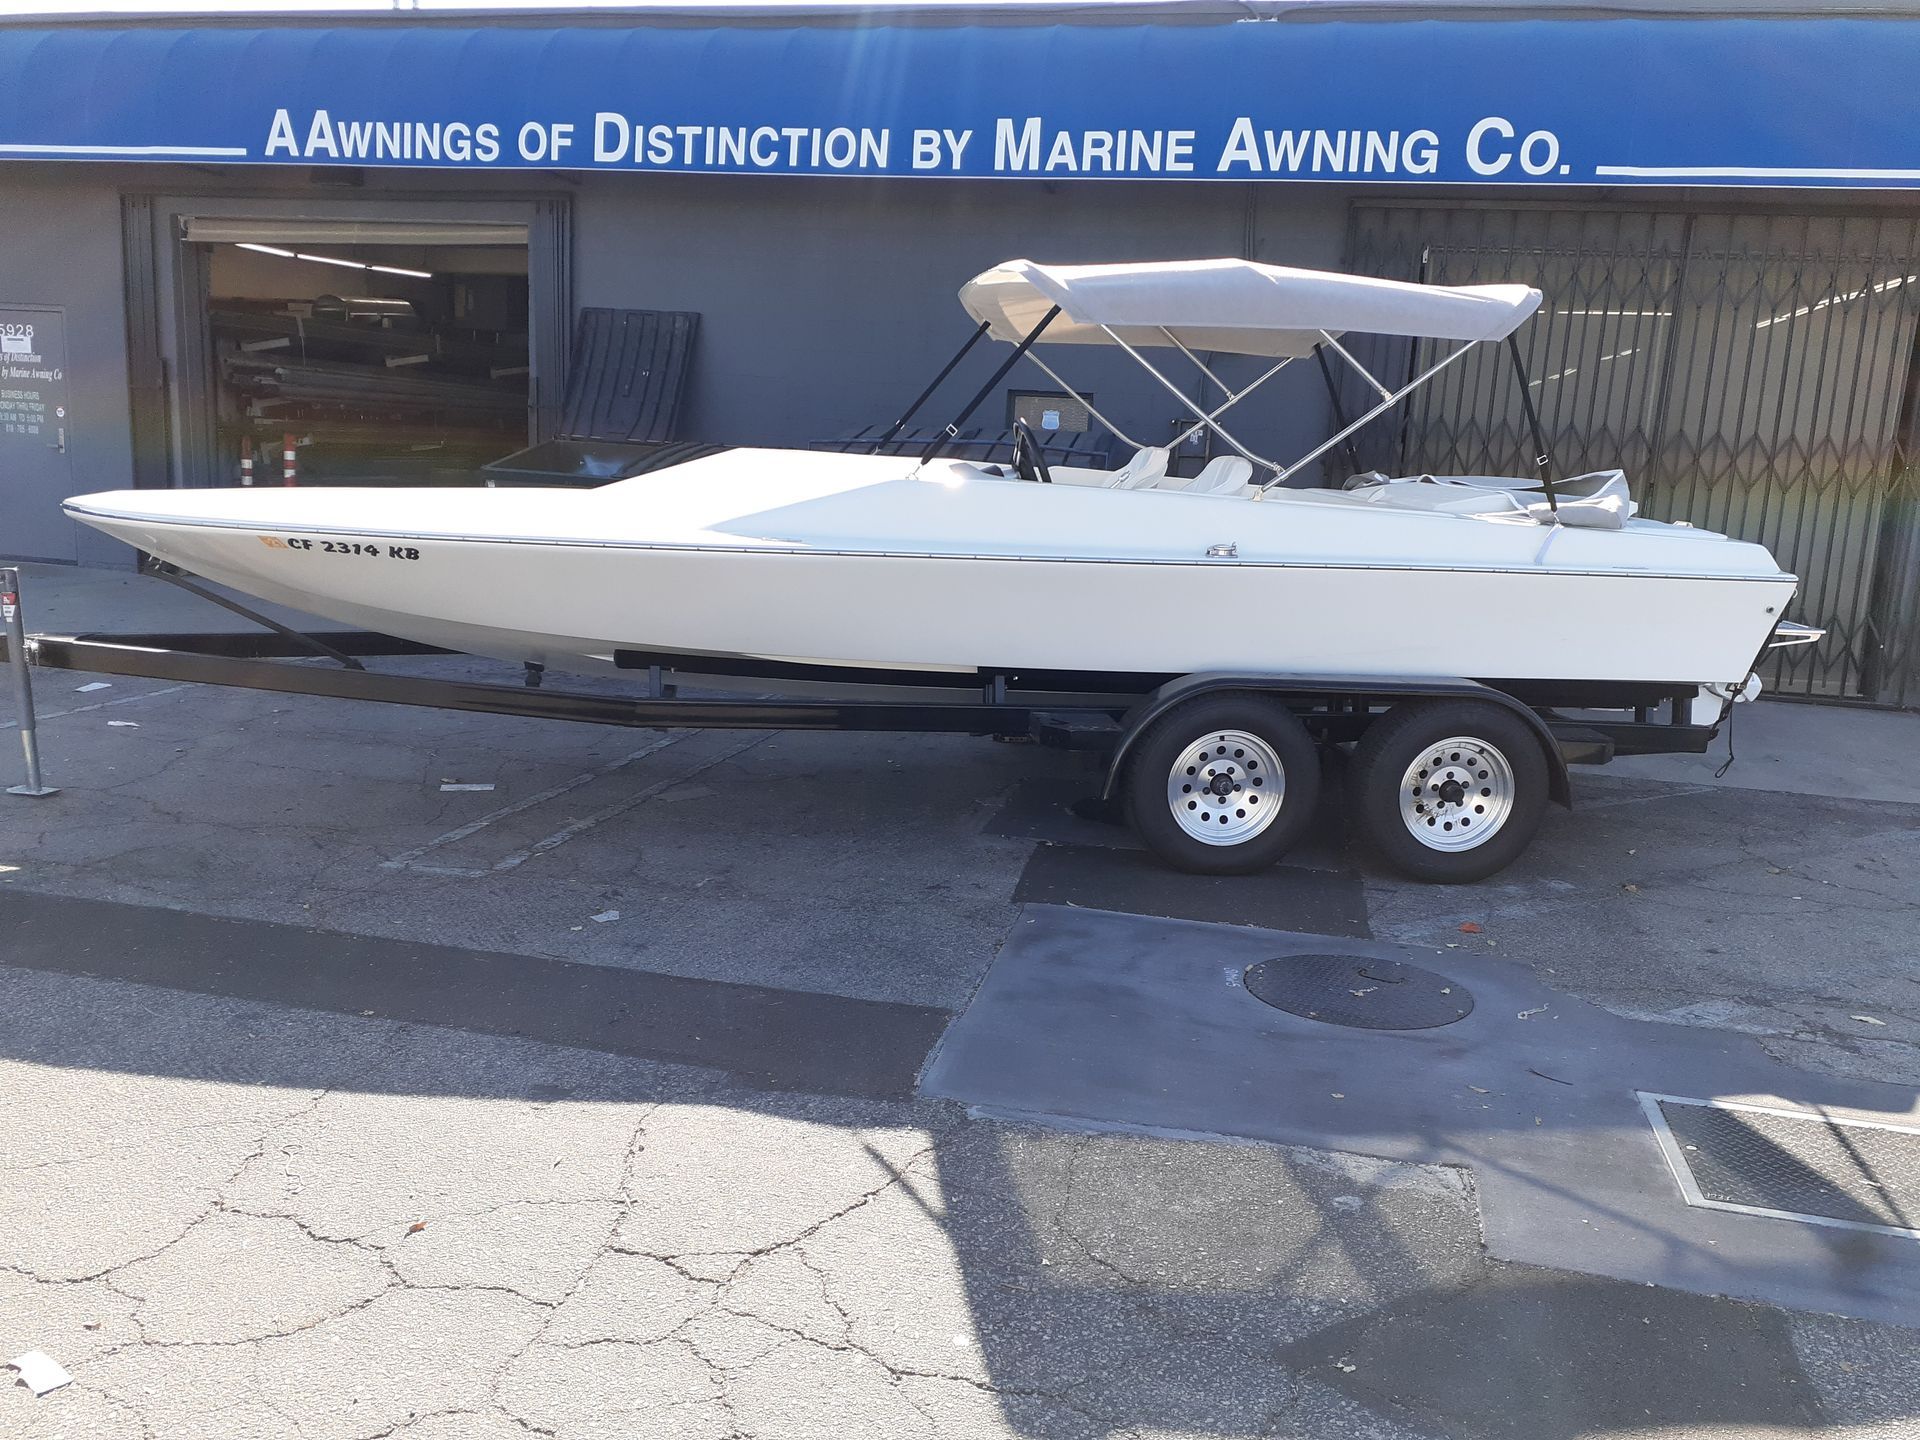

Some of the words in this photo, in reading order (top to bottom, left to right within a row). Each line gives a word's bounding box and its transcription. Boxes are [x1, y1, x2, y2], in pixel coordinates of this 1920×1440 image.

[518, 121, 574, 161] OF
[593, 112, 890, 168] DISTINCTION
[912, 129, 973, 170] BY
[994, 116, 1195, 172] MARINE
[1216, 116, 1439, 175] AWNING
[1465, 116, 1571, 176] CO.
[0, 323, 33, 337] 5928
[1, 365, 8, 380] by
[9, 366, 30, 378] Marine
[31, 368, 53, 382] Awning
[287, 537, 313, 551] CF
[320, 541, 380, 557] 2314
[388, 545, 420, 561] KB
